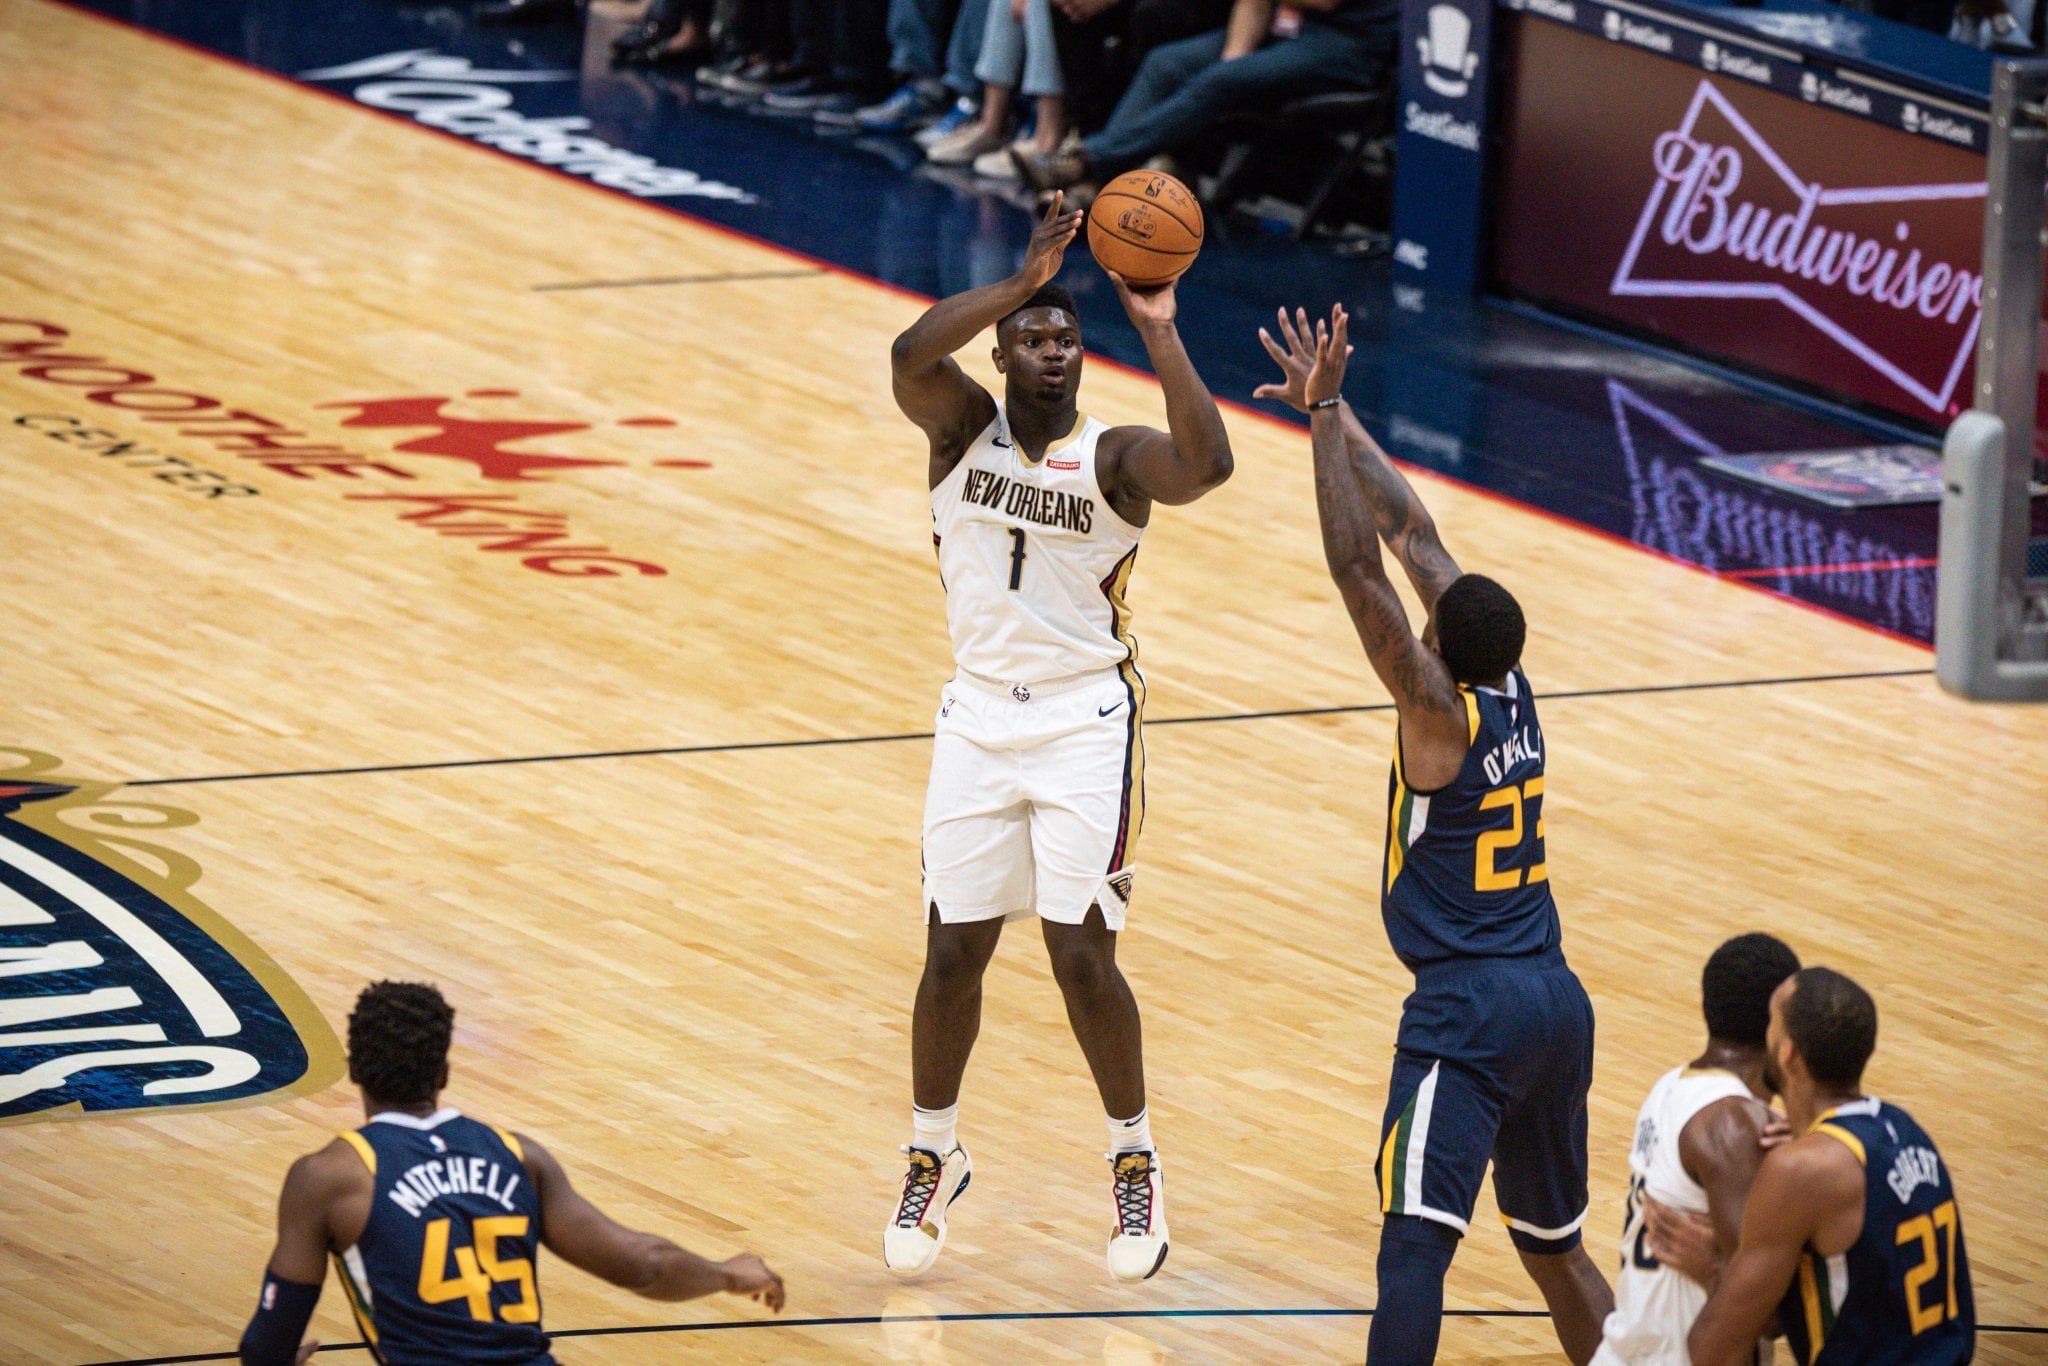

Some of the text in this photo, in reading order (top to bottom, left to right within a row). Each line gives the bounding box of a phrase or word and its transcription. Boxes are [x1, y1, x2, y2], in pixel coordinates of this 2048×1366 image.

[1719, 49, 1772, 84] SeatGeek
[1819, 81, 1872, 114] SeatGeek
[1405, 102, 1480, 151] SeatGeek
[1920, 111, 1974, 145] SeatGeek
[1653, 130, 1984, 324] Budweiser
[13, 413, 261, 500] CENTER
[961, 468, 1094, 534] NEW ORLEANS
[341, 492, 668, 577] KING
[1007, 526, 1027, 593] 1
[1482, 725, 1542, 786] O'NEAL
[388, 1156, 521, 1218] MITCHELL
[1887, 1146, 1940, 1205] GOBERT
[417, 1214, 541, 1325] 45
[1895, 1199, 1959, 1337] 27
